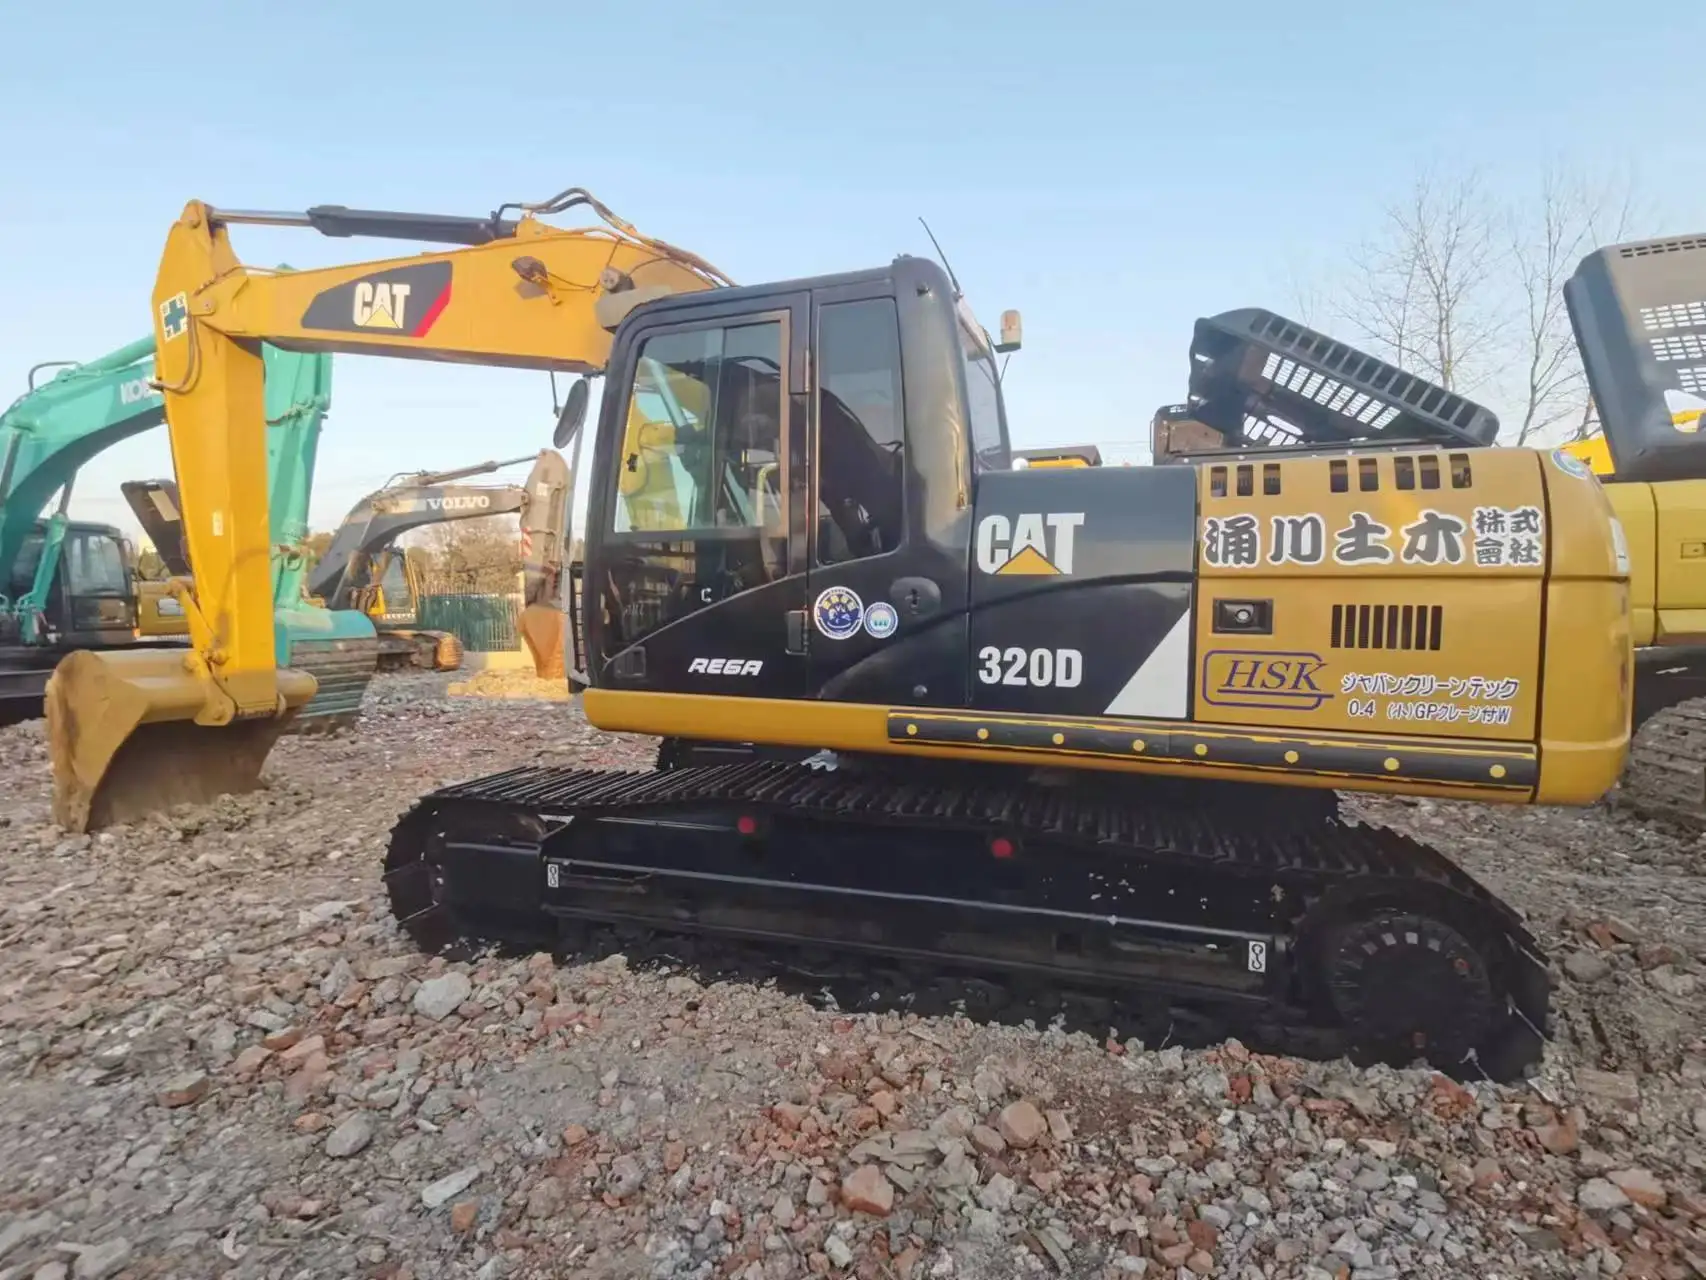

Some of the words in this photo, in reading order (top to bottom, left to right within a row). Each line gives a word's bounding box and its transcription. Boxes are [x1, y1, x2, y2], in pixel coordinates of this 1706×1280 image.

[353, 282, 410, 328] CAT
[428, 495, 490, 510] VOLVO
[977, 512, 1085, 575] CAT
[978, 646, 1083, 688] 320D
[1220, 660, 1328, 691] HSK
[1348, 699, 1375, 717] 0.4
